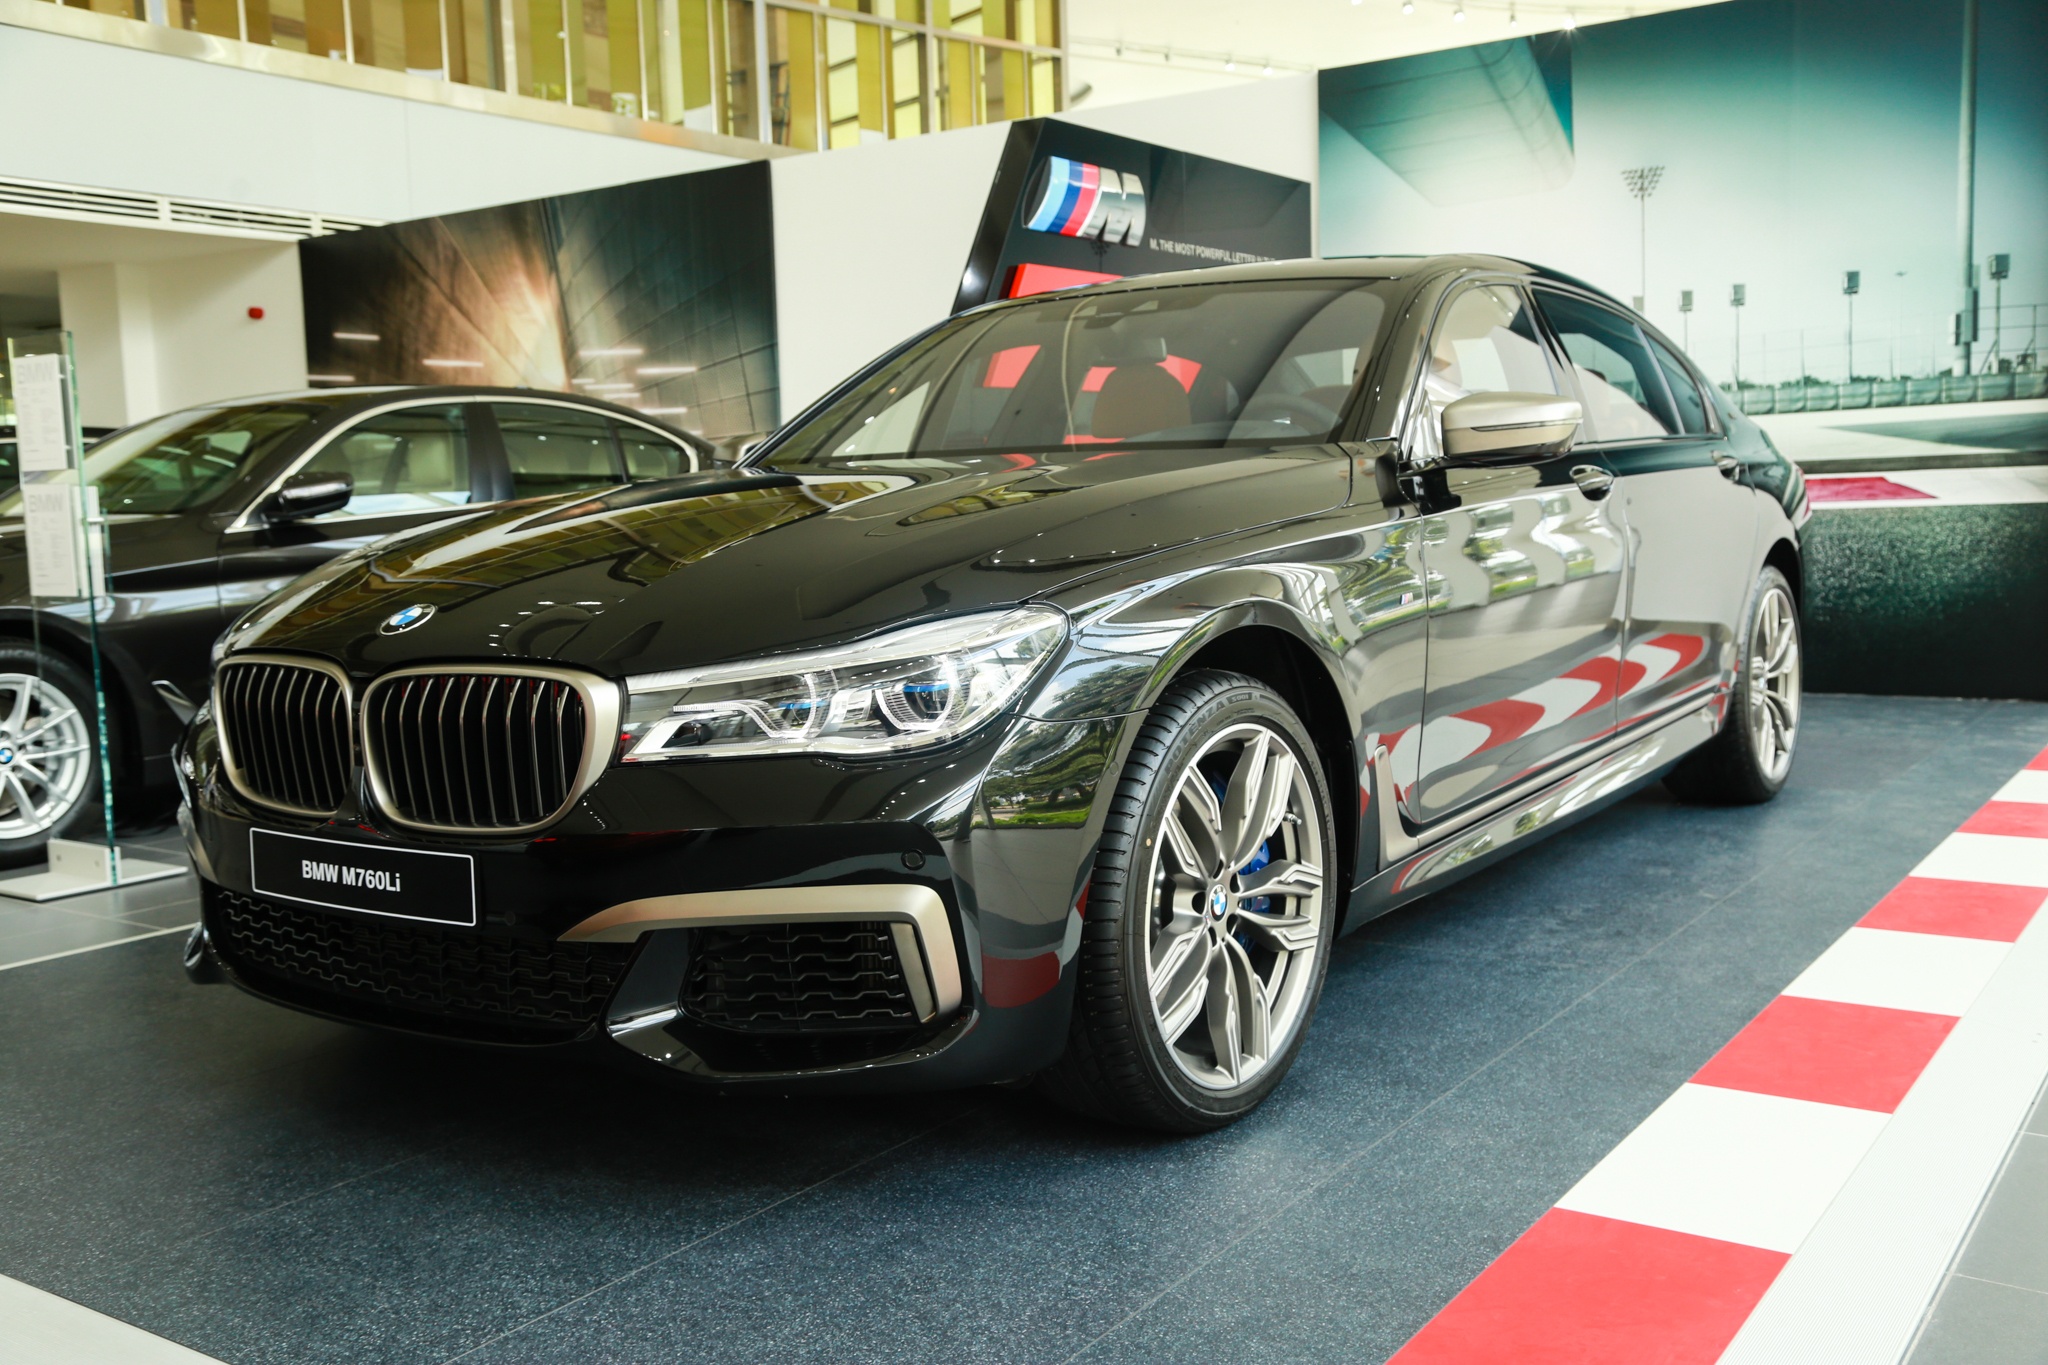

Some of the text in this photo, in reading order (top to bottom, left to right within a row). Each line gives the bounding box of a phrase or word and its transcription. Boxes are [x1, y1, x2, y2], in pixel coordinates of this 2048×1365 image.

[1079, 166, 1146, 247] M
[1160, 239, 1174, 253] THE
[1175, 242, 1196, 256] MOST
[1197, 245, 1231, 263] POWERFUL
[1165, 701, 1226, 775] POTENZA
[302, 860, 401, 892] BMW M760Li
